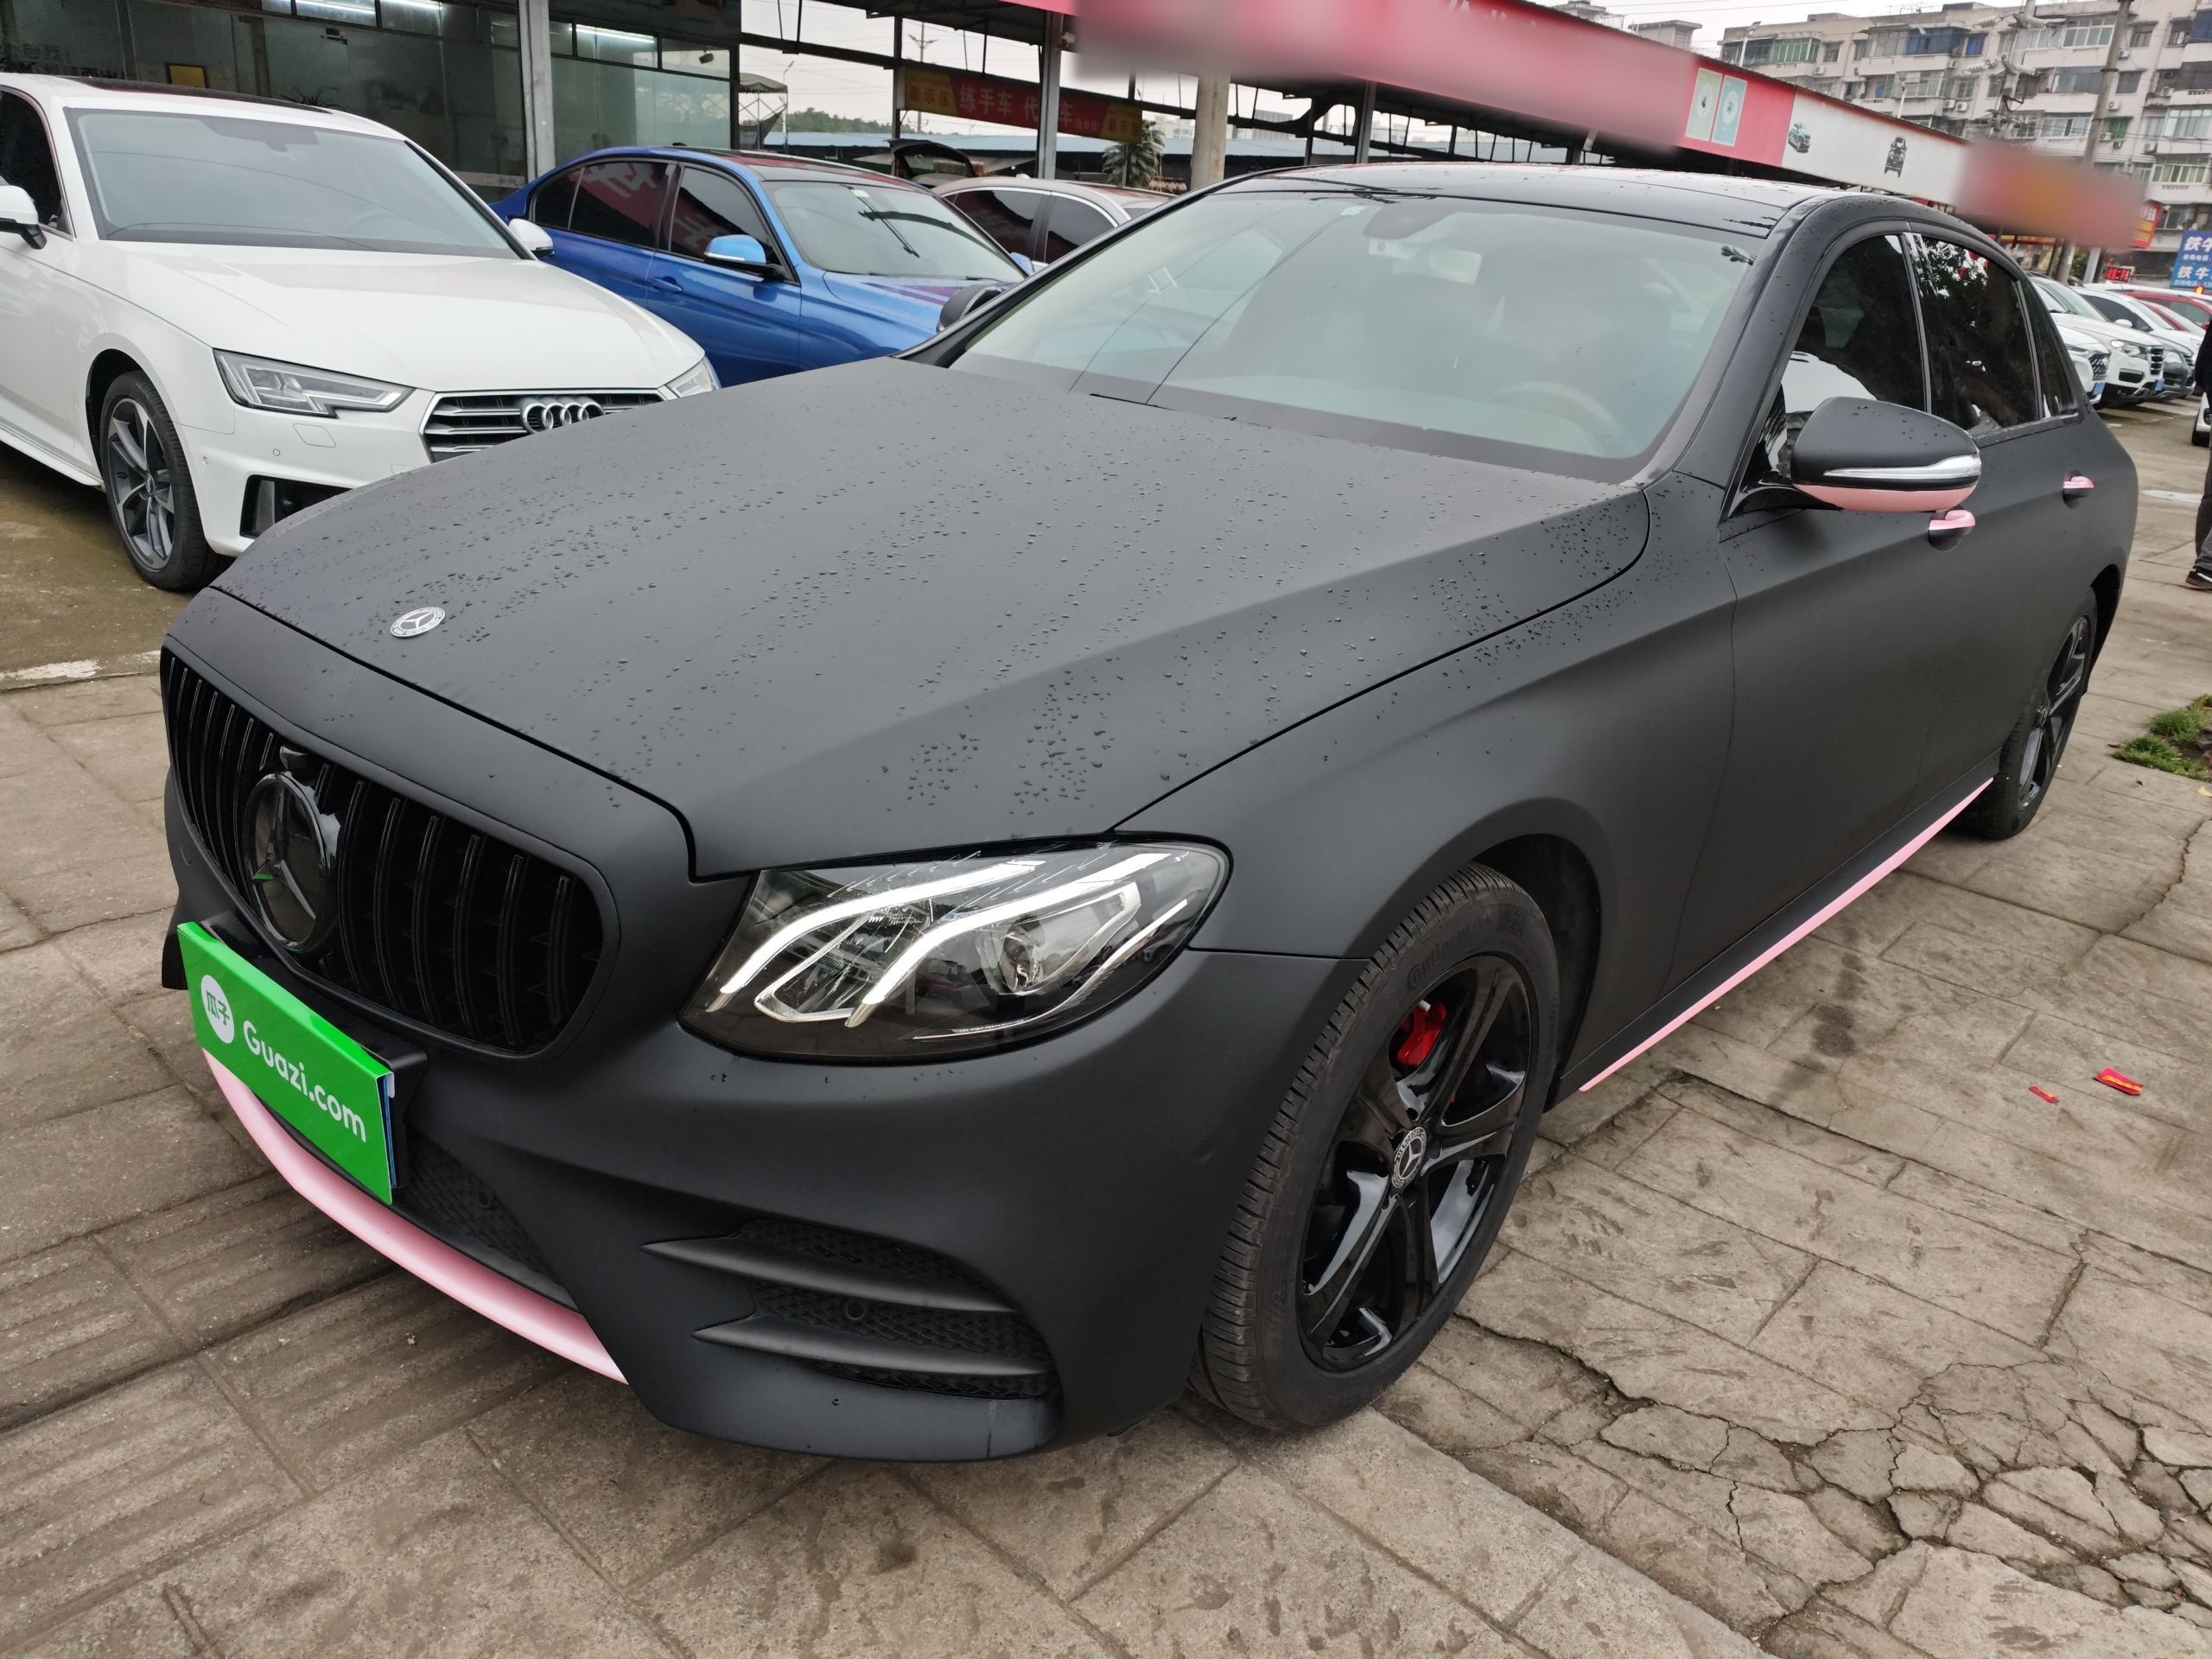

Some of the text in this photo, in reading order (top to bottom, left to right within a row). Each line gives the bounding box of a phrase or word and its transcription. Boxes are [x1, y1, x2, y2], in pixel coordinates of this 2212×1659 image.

[959, 84, 1014, 118] 练手车
[1023, 95, 1074, 128] 代车
[2177, 265, 2212, 281] 铁牛
[206, 989, 231, 1027] 瓜子
[243, 1020, 367, 1143] Guazi.com
